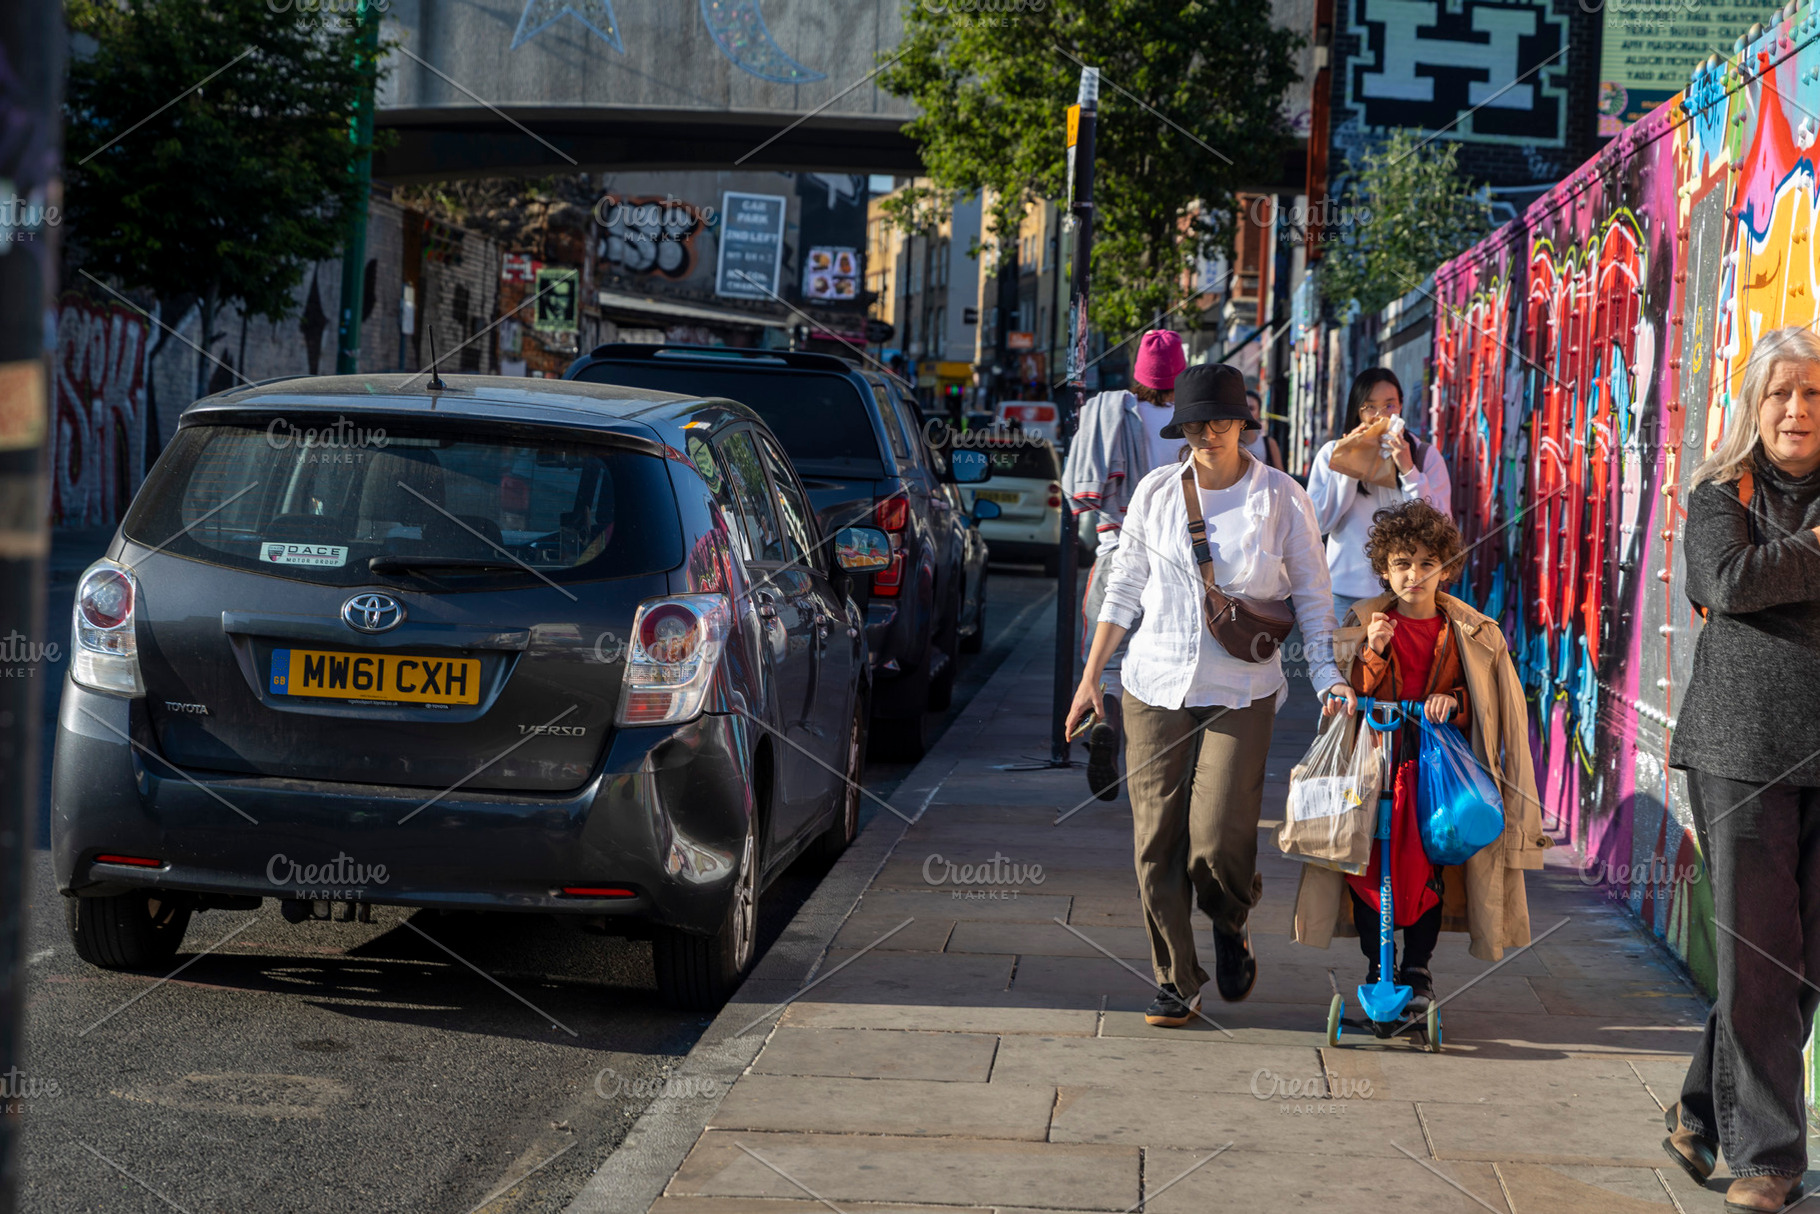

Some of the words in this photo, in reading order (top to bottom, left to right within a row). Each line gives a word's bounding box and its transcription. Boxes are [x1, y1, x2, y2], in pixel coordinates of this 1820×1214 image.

[1362, 0, 1536, 109] H
[288, 545, 341, 556] DACE
[273, 675, 286, 685] GB
[303, 654, 385, 692] MW61
[396, 660, 468, 697] CXH
[165, 701, 209, 715] TOYOTA
[518, 724, 586, 737] VERSO
